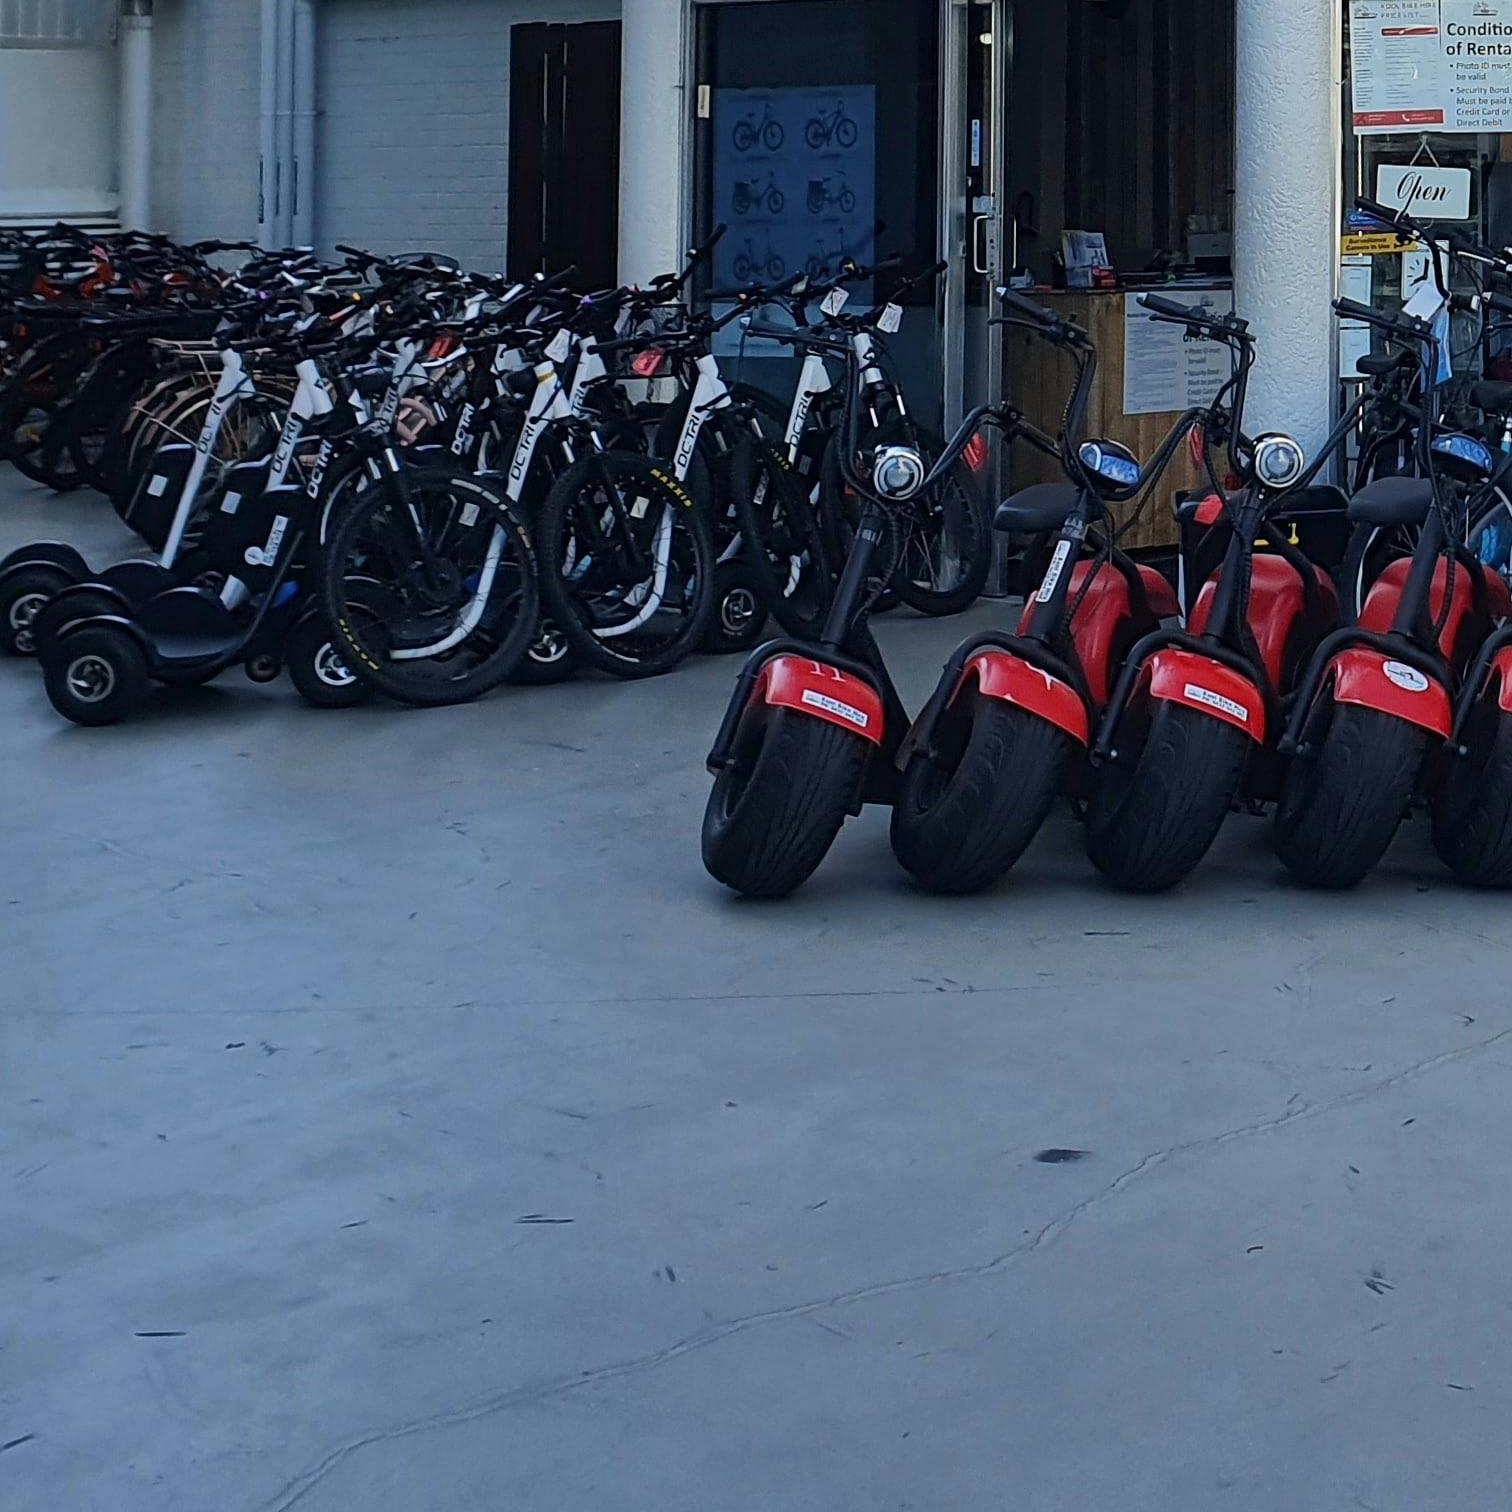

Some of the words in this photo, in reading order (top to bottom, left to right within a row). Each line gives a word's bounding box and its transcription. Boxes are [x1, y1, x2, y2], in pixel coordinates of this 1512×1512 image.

[1446, 41, 1463, 56] of
[1456, 86, 1487, 95] Security
[1490, 86, 1510, 94] Bond
[1456, 97, 1476, 105] Must
[1490, 97, 1507, 106] paid
[1456, 108, 1480, 116] Credit
[1482, 108, 1500, 116] Card
[1456, 119, 1480, 127] Direct
[1482, 119, 1503, 127] Debit
[1396, 171, 1451, 210] Open
[677, 414, 700, 469] DCTRI
[510, 423, 535, 481] DCTRI
